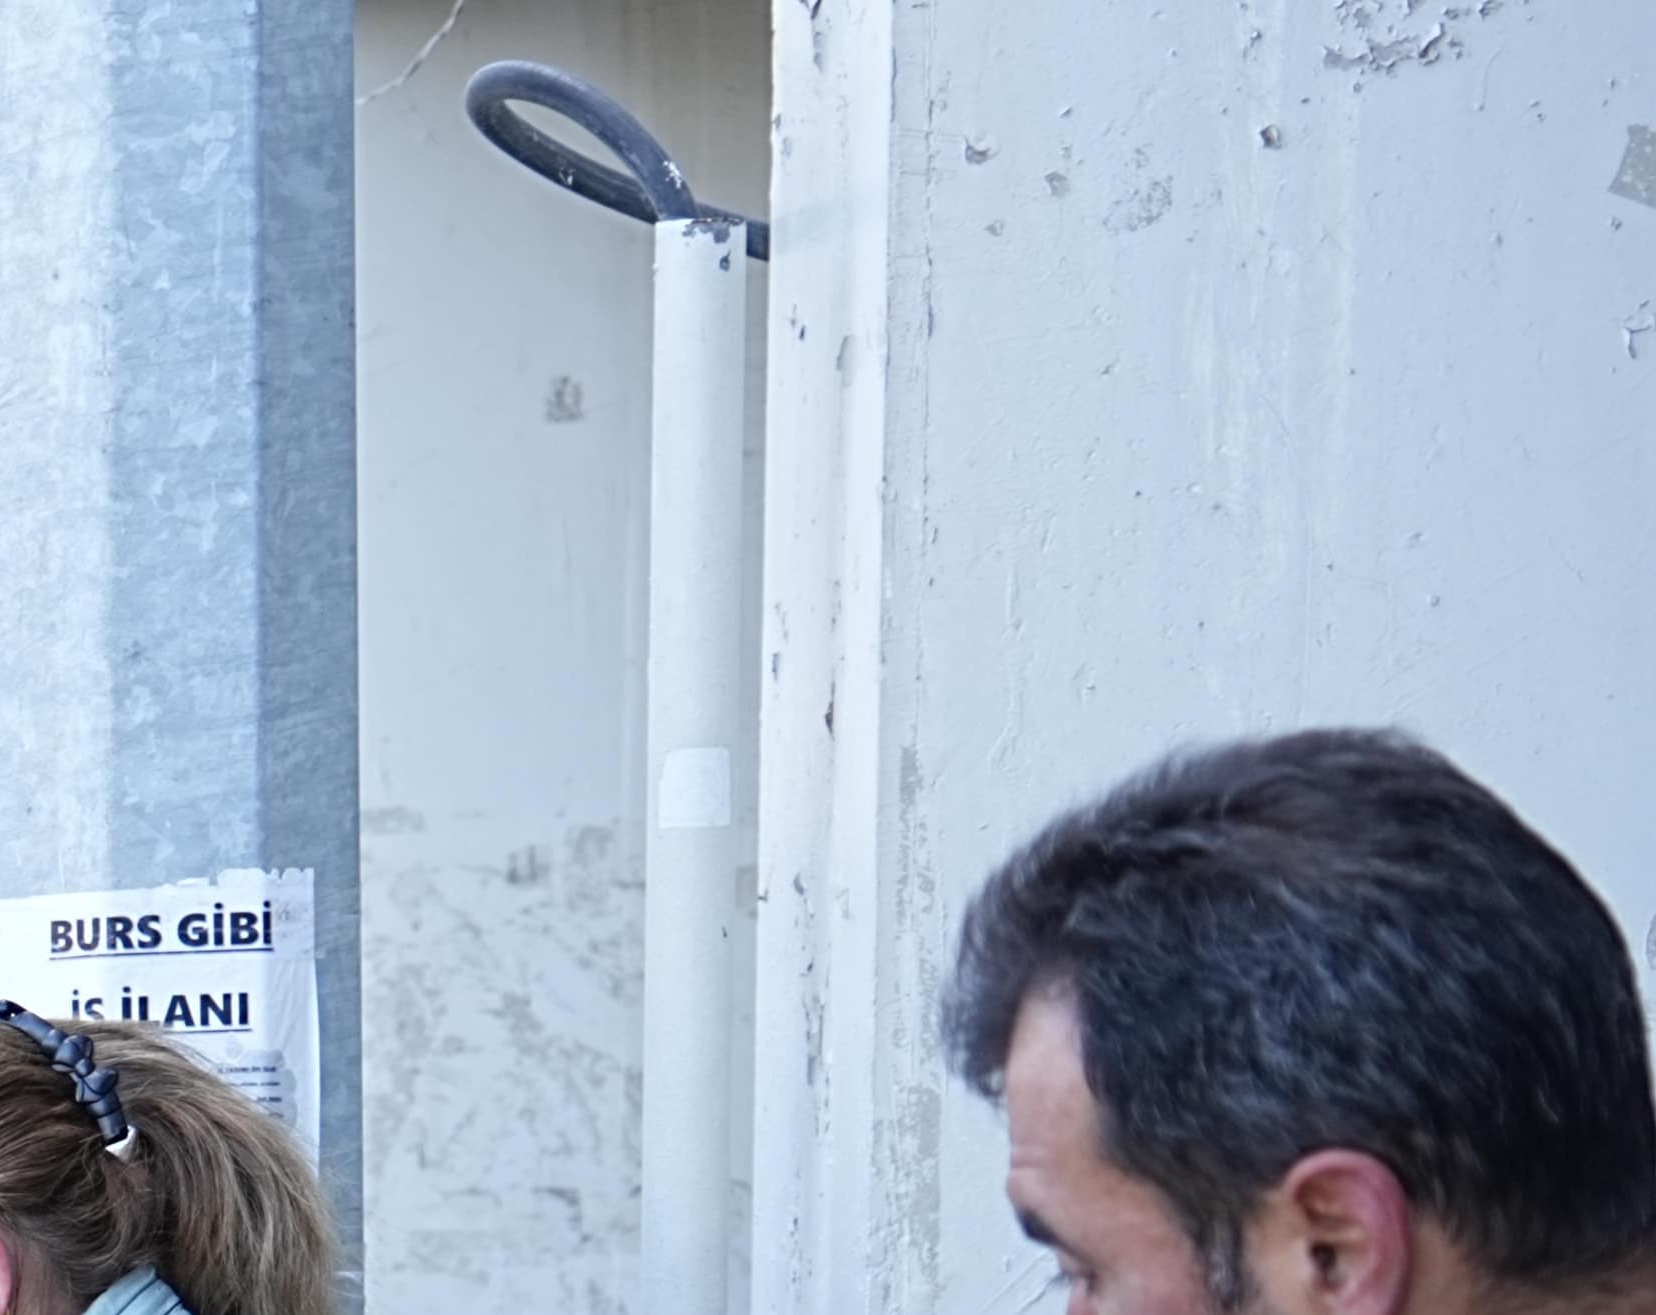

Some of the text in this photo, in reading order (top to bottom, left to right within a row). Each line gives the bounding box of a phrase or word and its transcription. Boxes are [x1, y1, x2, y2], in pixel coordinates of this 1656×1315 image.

[49, 899, 274, 953] BURS GİBİ
[121, 984, 250, 1027] İLANI
